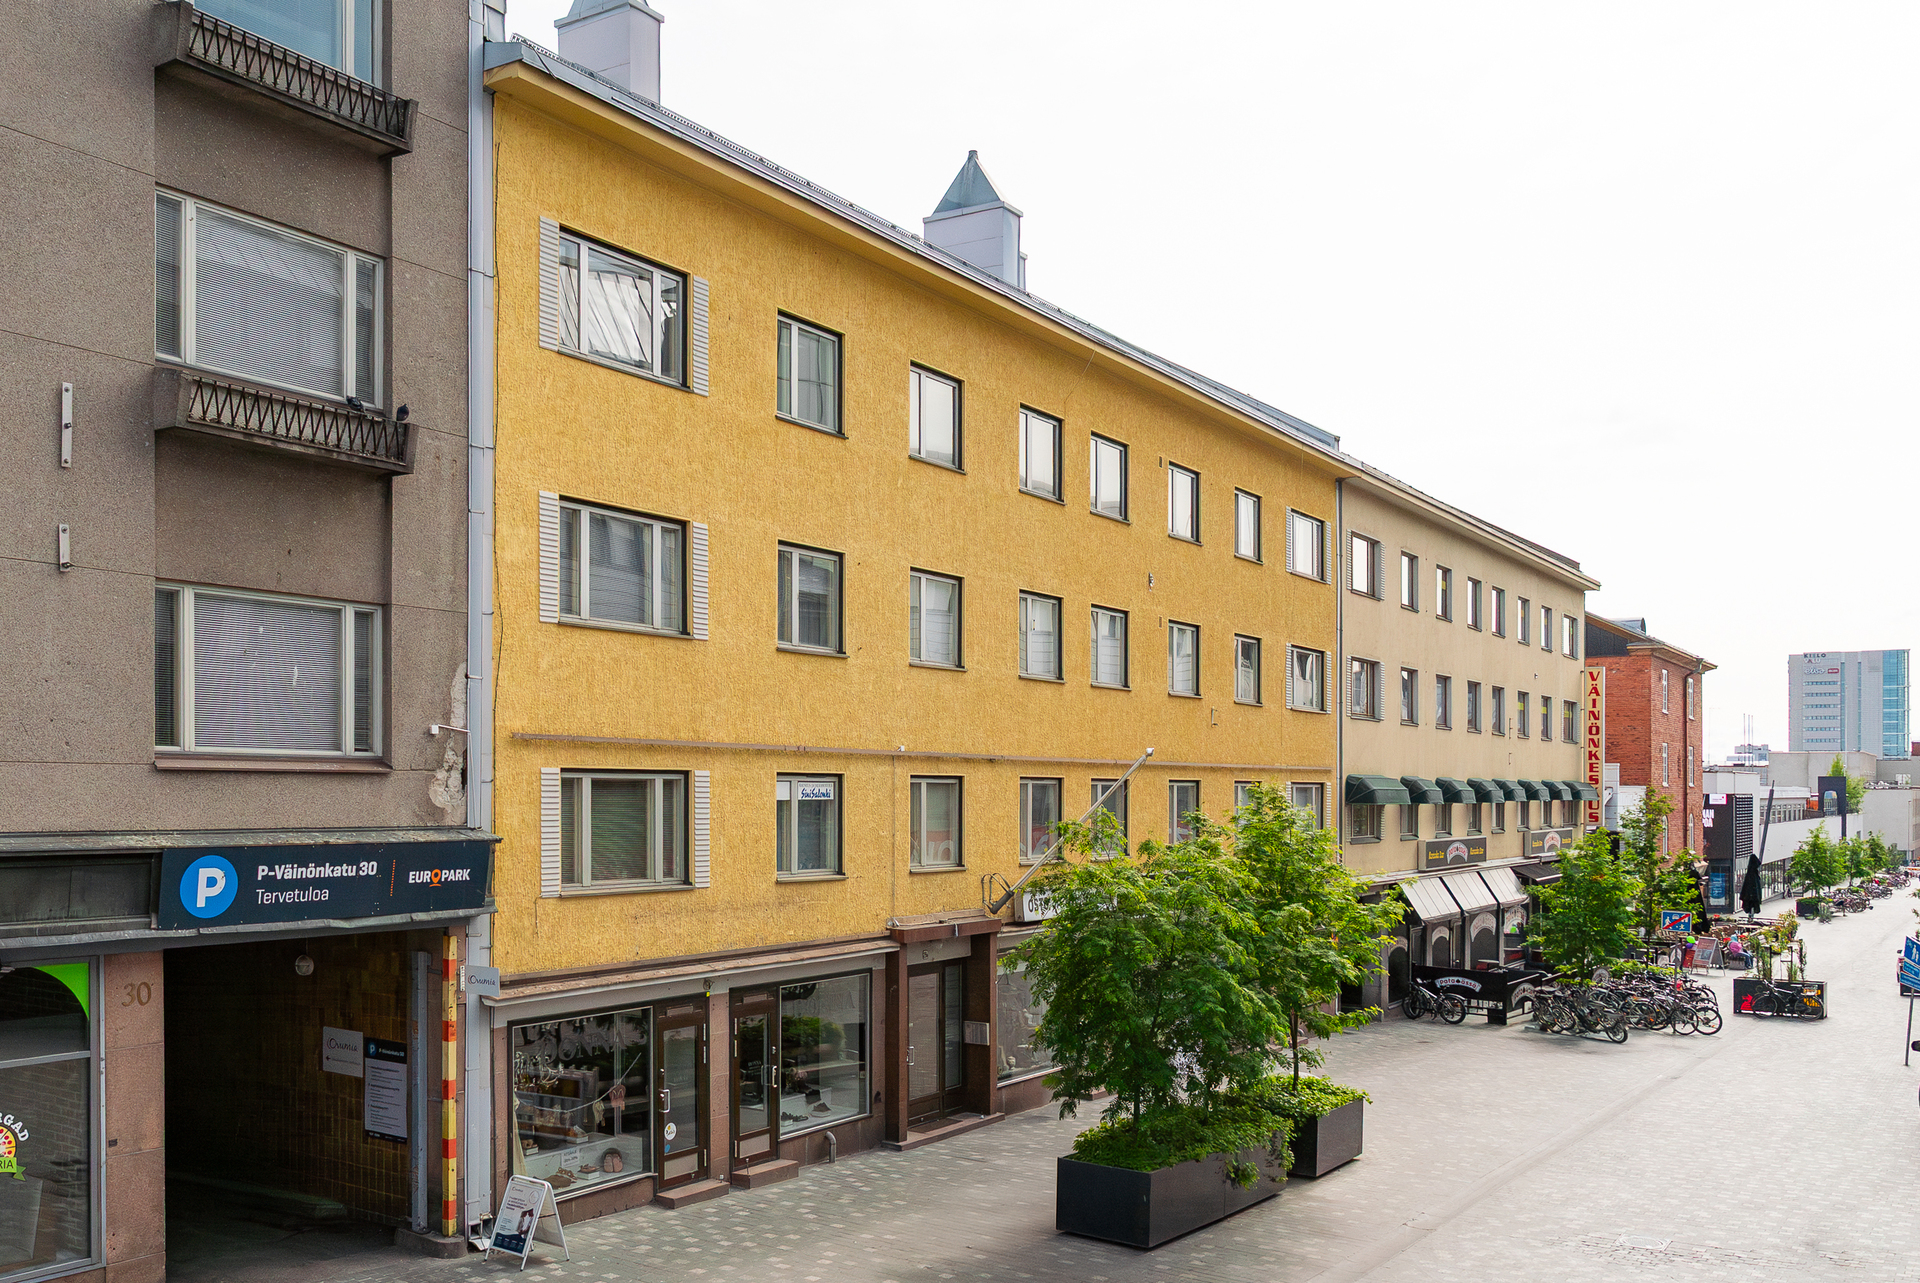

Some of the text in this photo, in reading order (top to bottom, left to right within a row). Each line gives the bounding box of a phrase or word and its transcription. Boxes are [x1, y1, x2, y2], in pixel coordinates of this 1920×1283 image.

[1587, 671, 1601, 823] VÄINÖNKESUS
[257, 861, 378, 881] P-Väinönkatu 30
[196, 867, 226, 908] P
[255, 886, 330, 905] Tervetuloa
[121, 981, 152, 1007] 30
